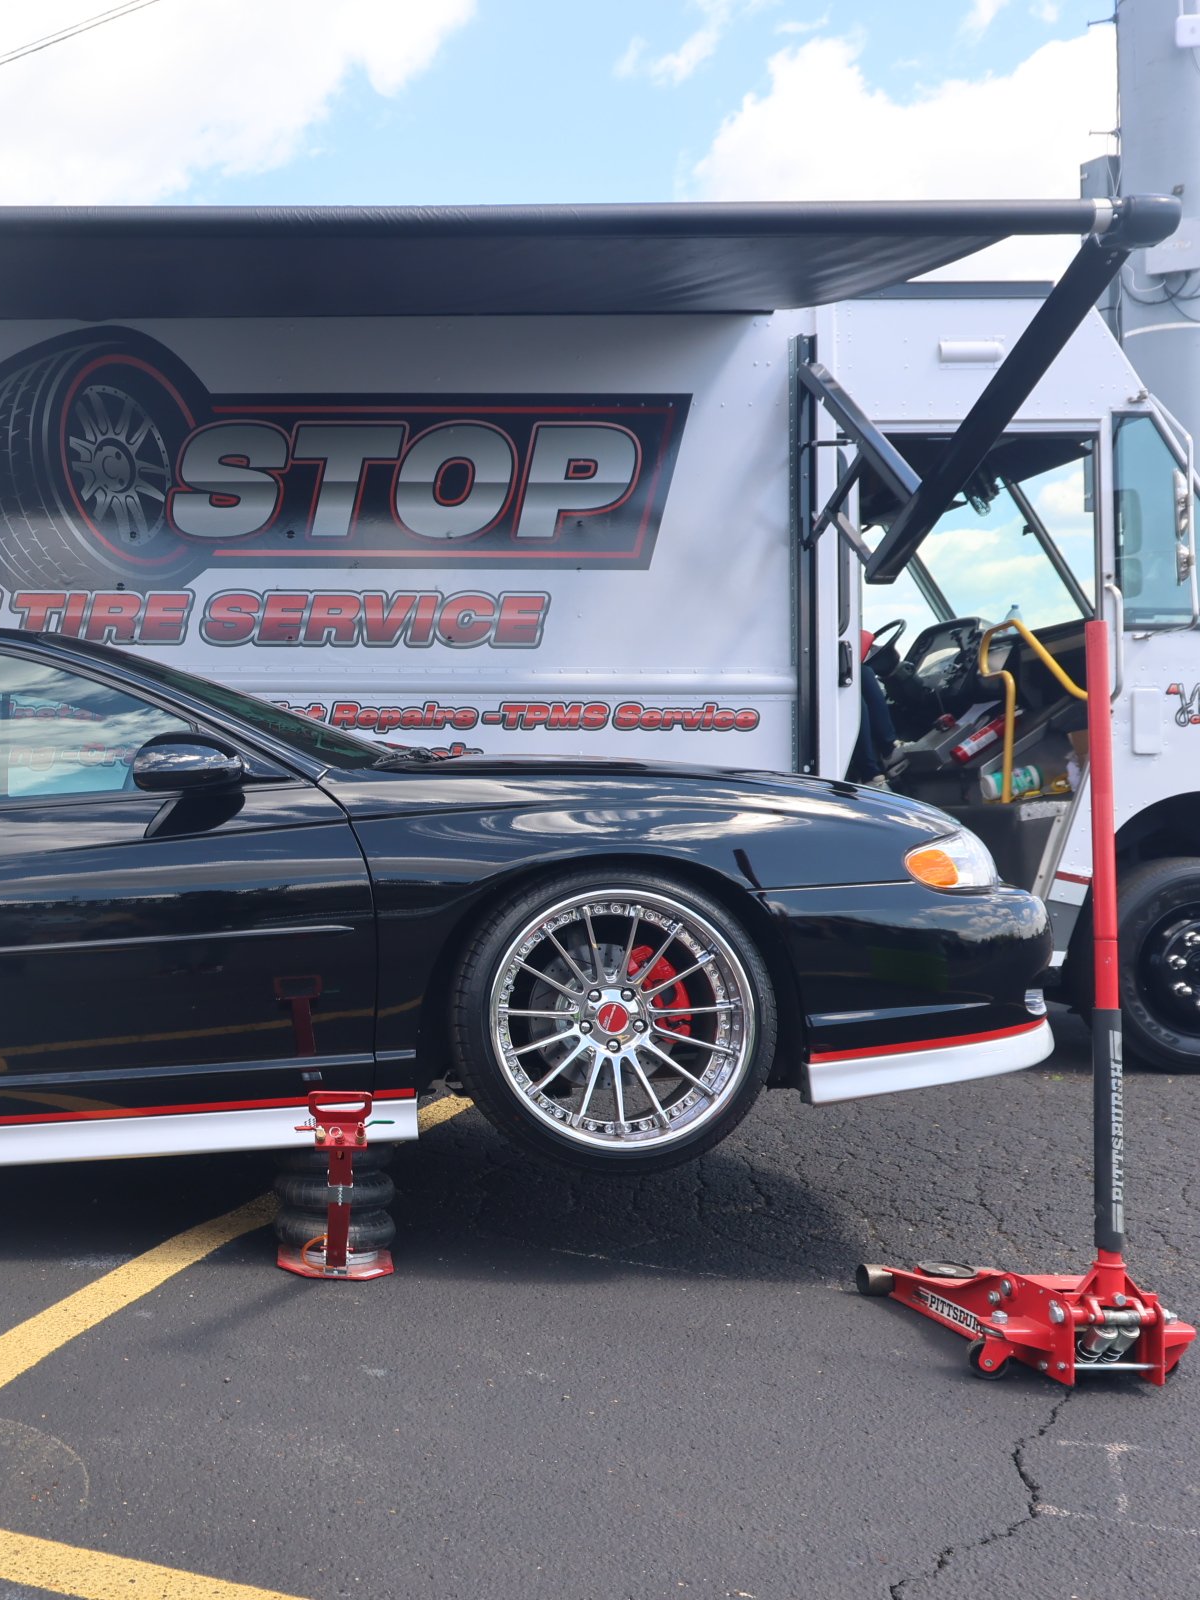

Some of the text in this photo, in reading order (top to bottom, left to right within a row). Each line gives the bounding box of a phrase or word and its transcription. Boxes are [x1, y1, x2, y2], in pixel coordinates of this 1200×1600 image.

[167, 419, 643, 544] STOP
[8, 588, 195, 647] TIRE
[200, 589, 552, 649] SERVICE
[330, 701, 478, 733] Repairs
[612, 702, 761, 732] Service
[1110, 1059, 1124, 1204] PITTSBURGH
